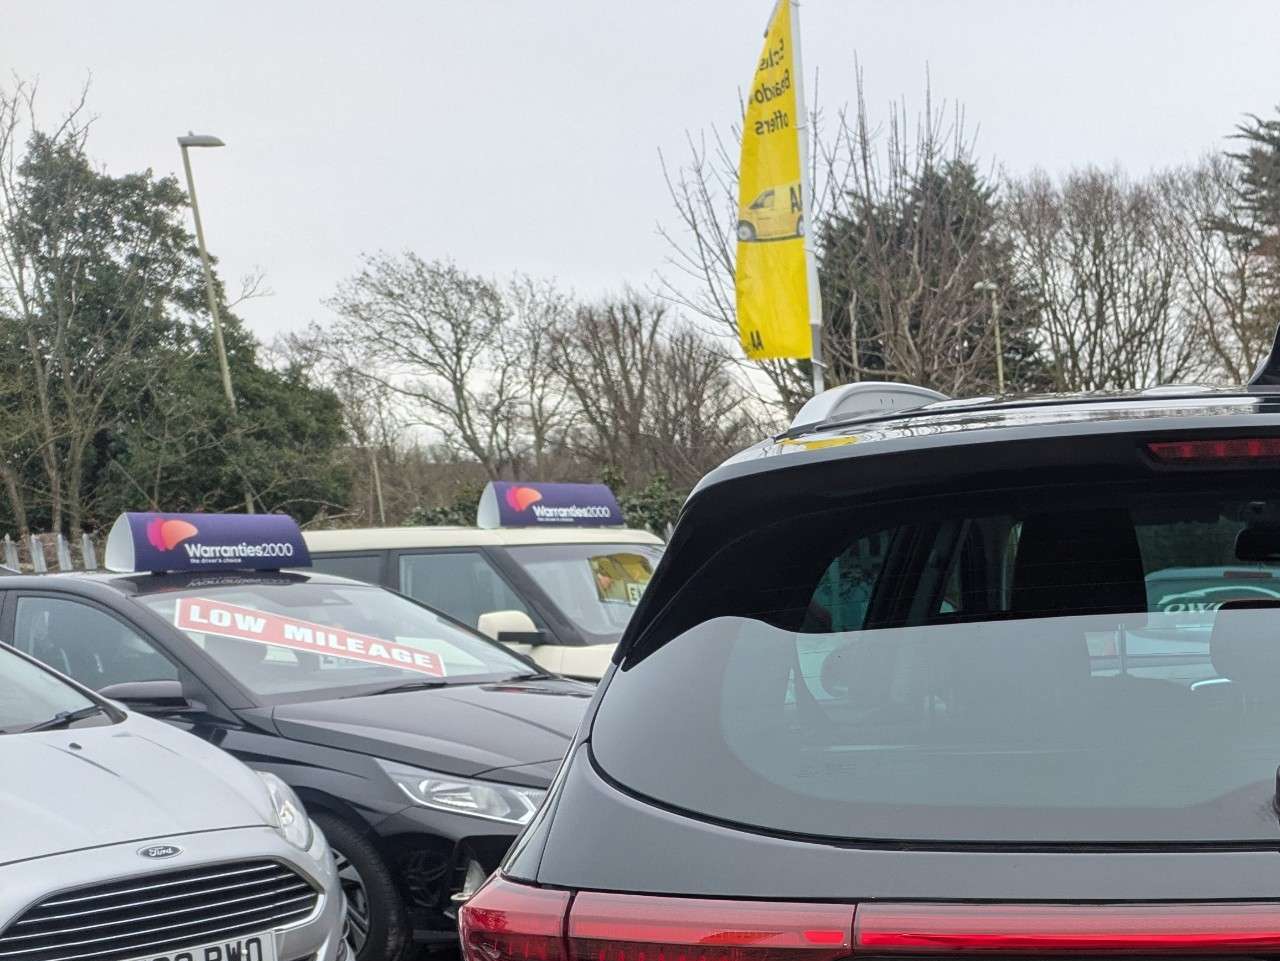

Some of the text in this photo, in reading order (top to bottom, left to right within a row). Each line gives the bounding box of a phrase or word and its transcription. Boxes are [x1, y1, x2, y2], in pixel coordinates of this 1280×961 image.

[532, 504, 611, 518] Warranties2000
[184, 542, 293, 558] Warranties2000
[189, 604, 433, 669] LOW MILEAGE
